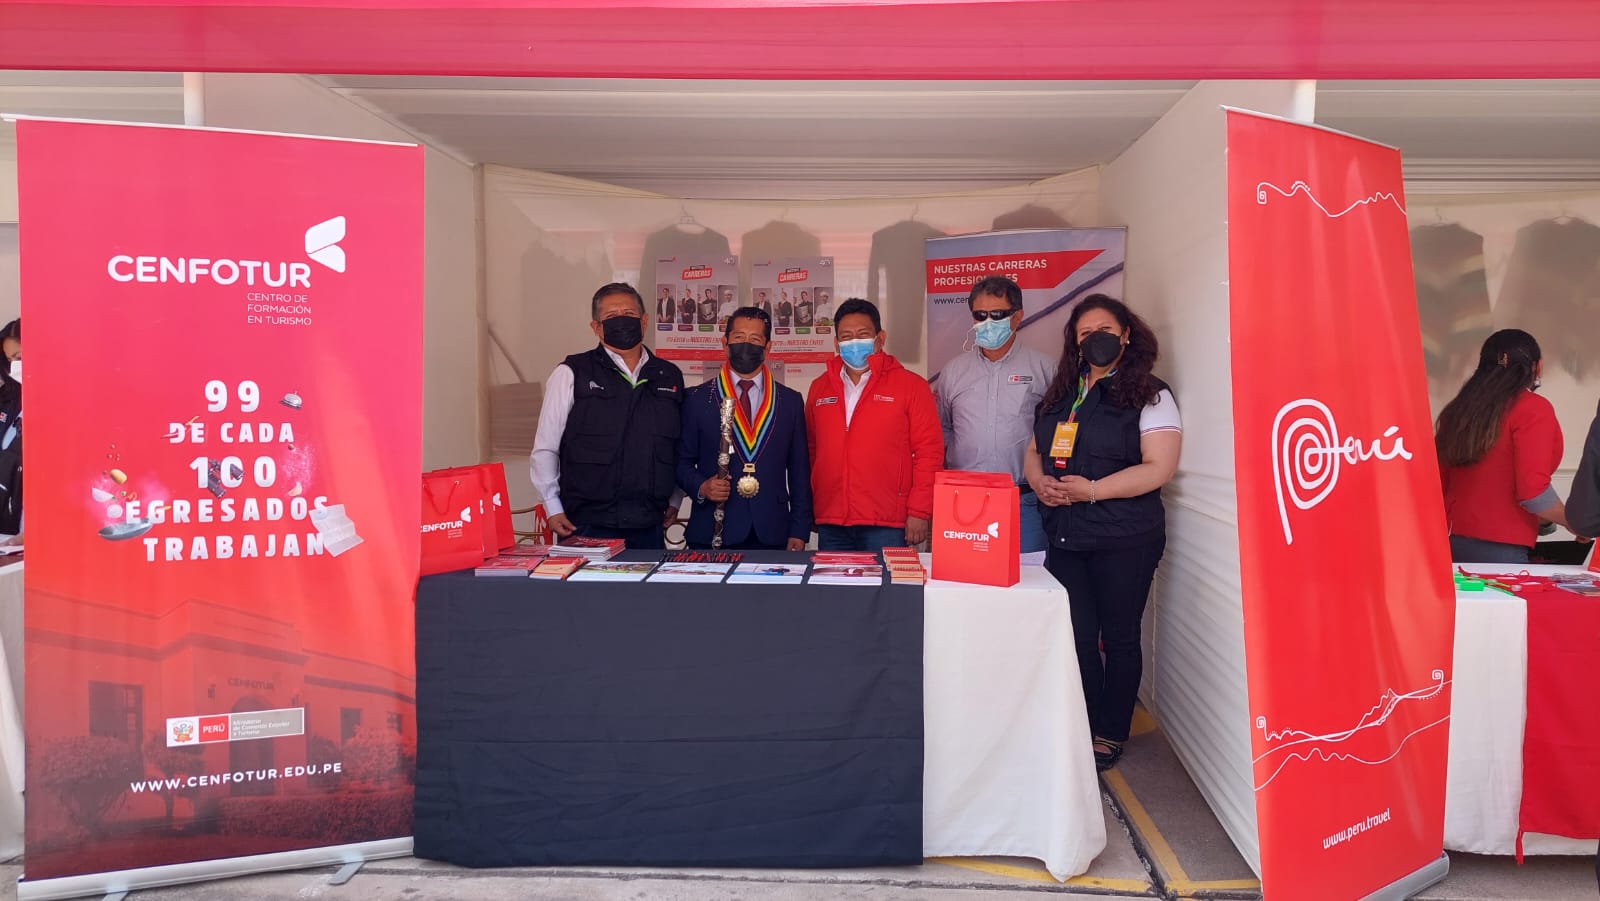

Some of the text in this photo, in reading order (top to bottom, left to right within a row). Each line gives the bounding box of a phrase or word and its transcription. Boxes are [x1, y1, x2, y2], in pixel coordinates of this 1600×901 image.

[107, 255, 311, 288] CENFOTUR
[934, 259, 1047, 274] NUESTRAS CARRERAS
[934, 273, 1018, 286] PROFESIOES
[247, 293, 308, 303] CENTRO DE
[247, 303, 311, 314] FORMACIÓN
[247, 316, 312, 325] EN TURISMO
[205, 380, 260, 412] 99
[169, 422, 295, 443] DE CADA
[190, 456, 276, 488] 100
[1272, 398, 1412, 545] Perú
[126, 496, 328, 524] EGRESADOS
[420, 521, 463, 532] ENFOTUR
[944, 530, 989, 542] CENFOTUR
[143, 533, 324, 561] TRABAJAN
[203, 723, 225, 734] PERÚ
[131, 762, 342, 793] WWW.CENFOTUR.EDU.PE
[1323, 808, 1391, 849] www.peru.travel
